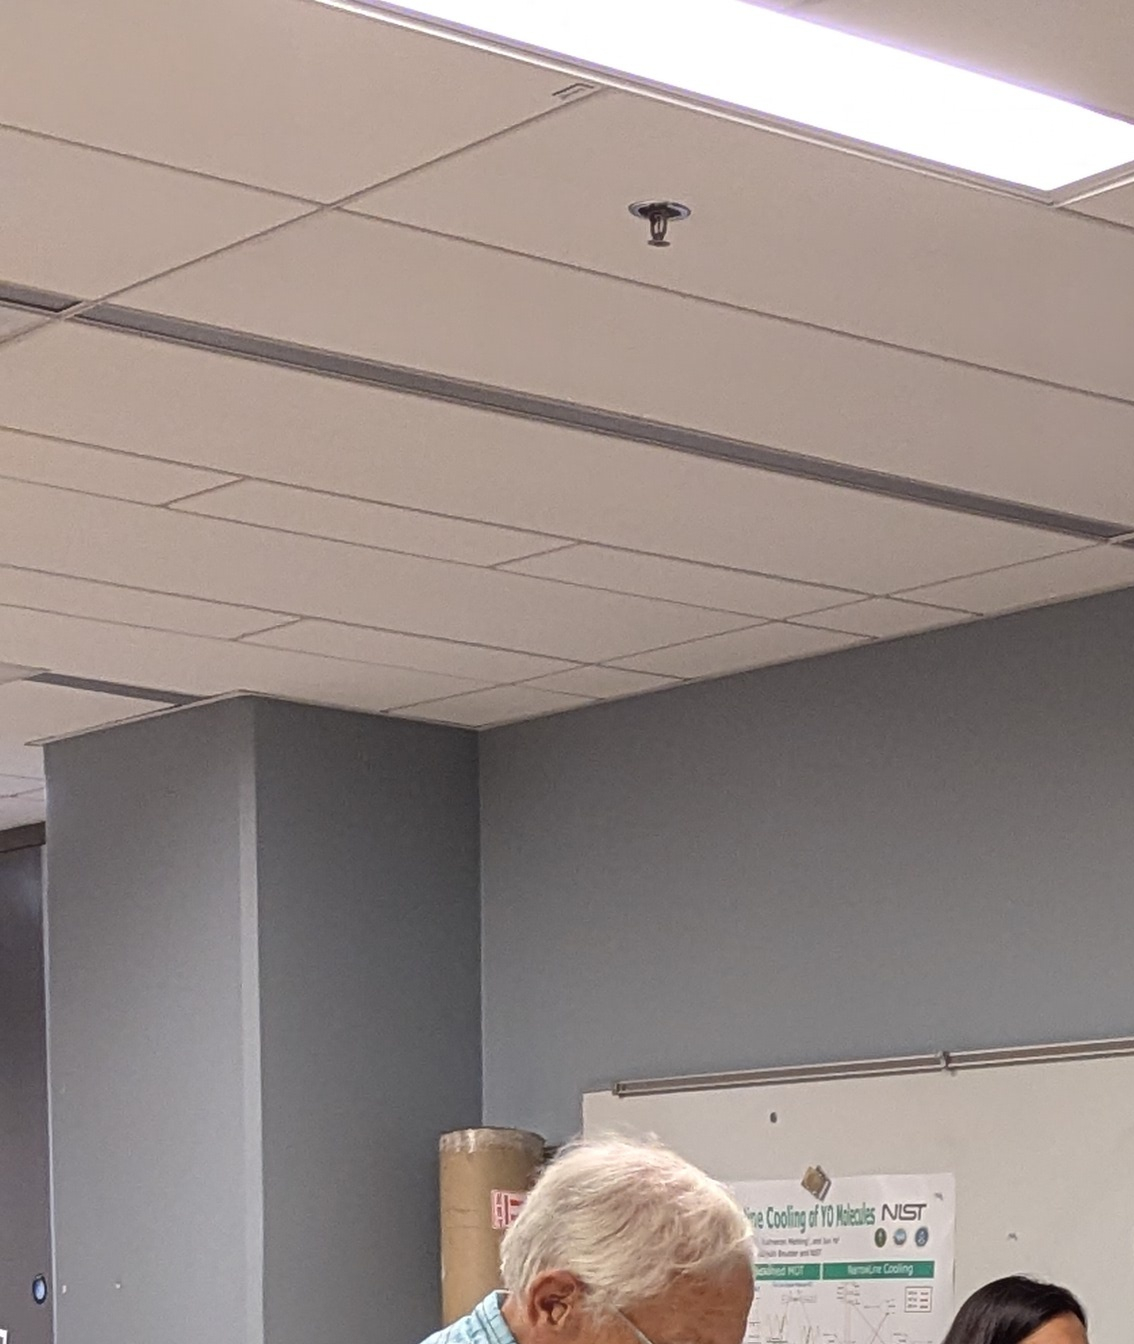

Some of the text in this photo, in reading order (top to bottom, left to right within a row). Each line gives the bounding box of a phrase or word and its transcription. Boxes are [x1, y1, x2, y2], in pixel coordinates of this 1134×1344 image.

[766, 1205, 806, 1233] Cooling
[808, 1203, 820, 1228] of
[820, 1204, 834, 1228] YO
[836, 1201, 876, 1228] Molecules
[881, 1203, 927, 1221] NIST
[883, 1263, 914, 1276] Cooling
